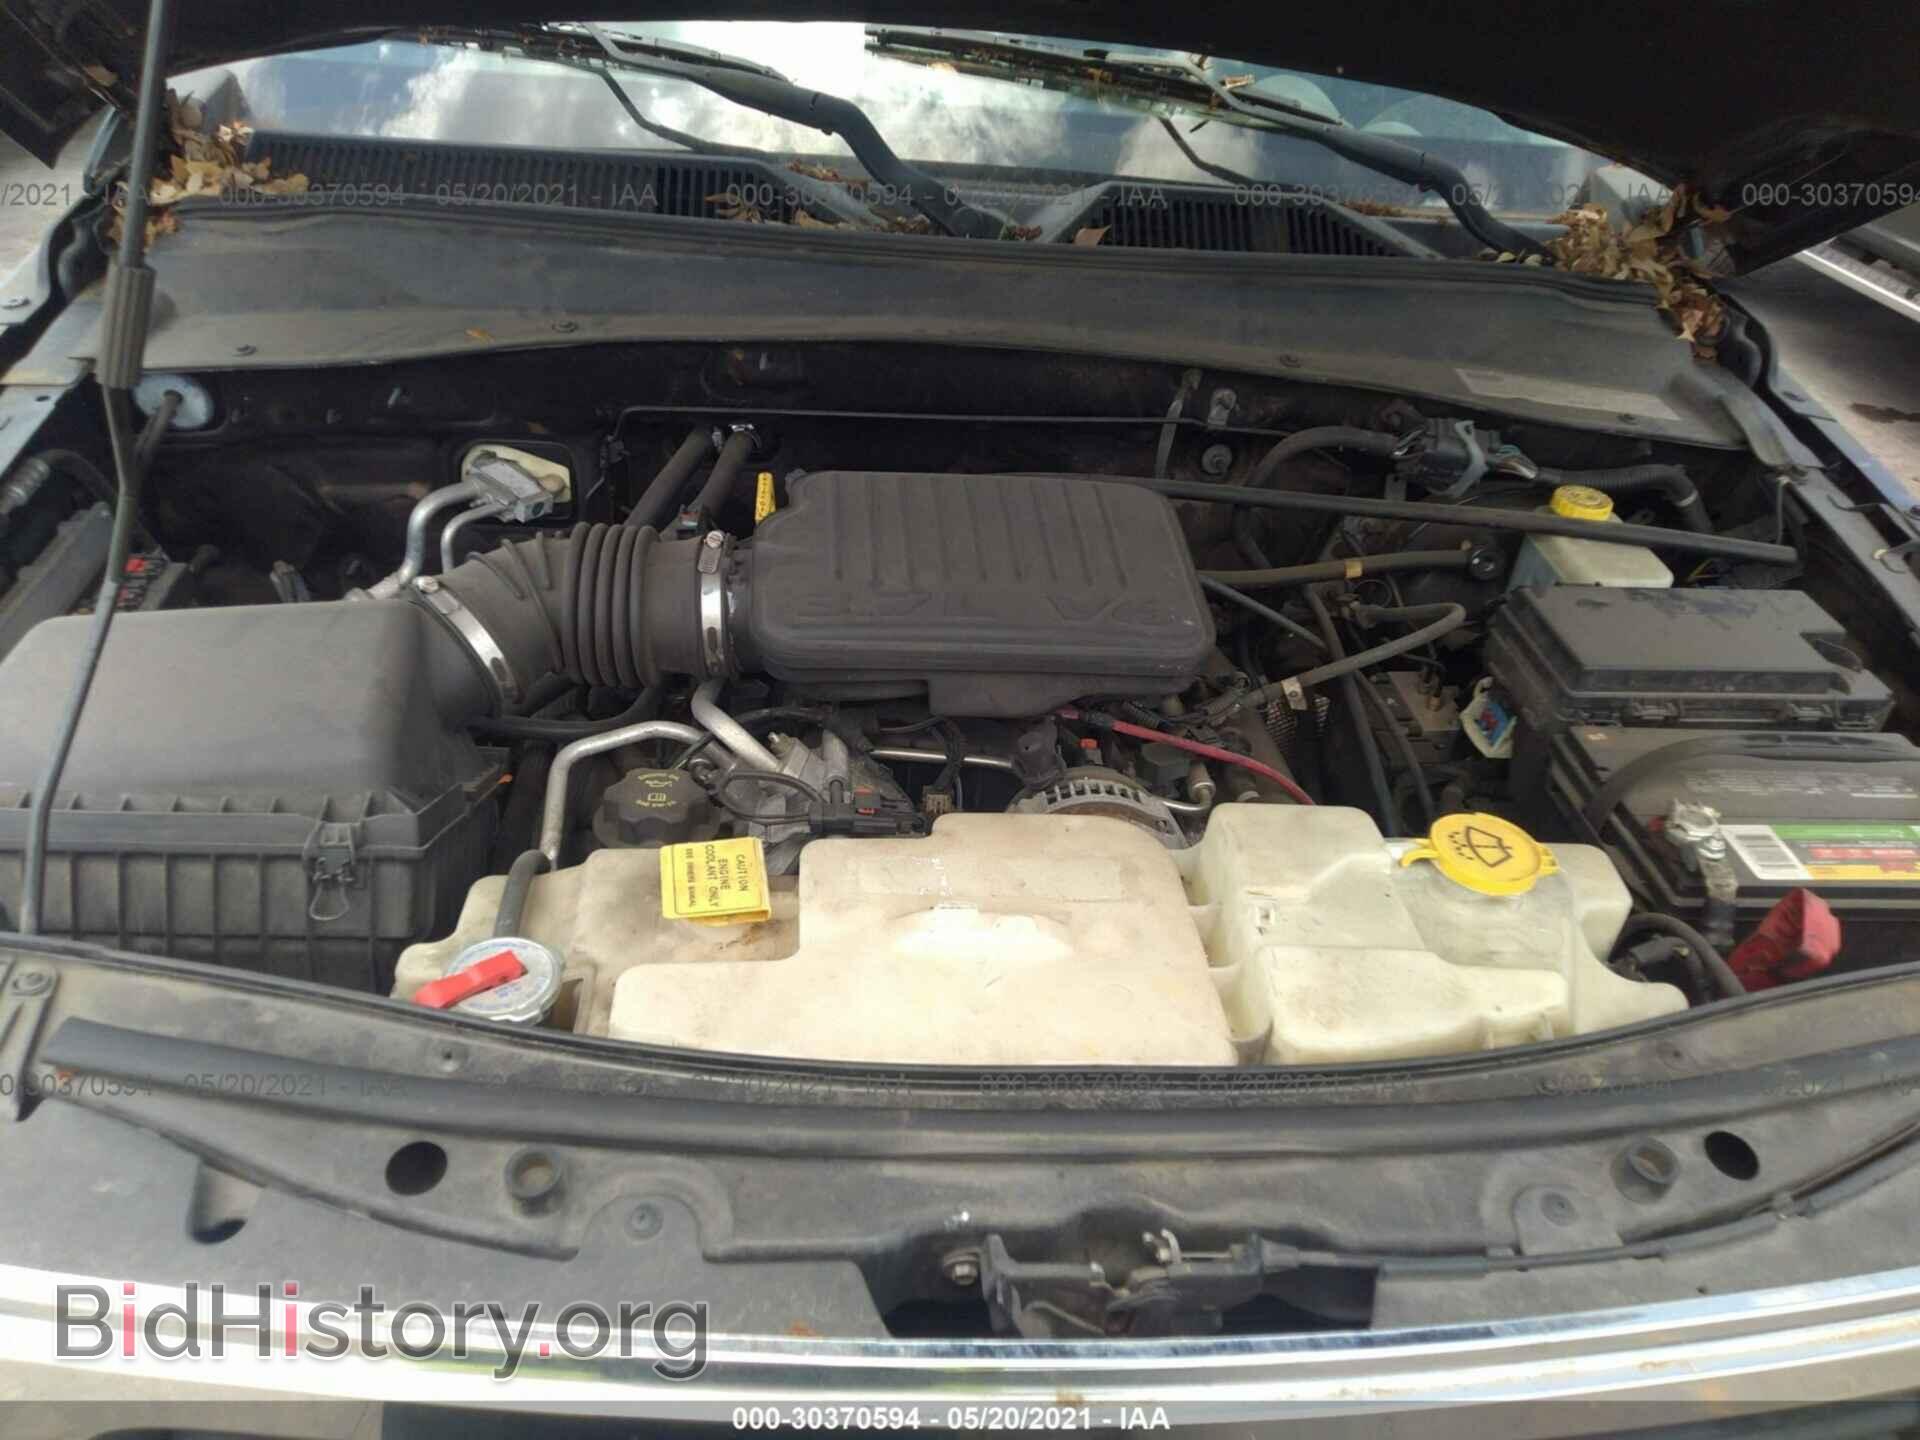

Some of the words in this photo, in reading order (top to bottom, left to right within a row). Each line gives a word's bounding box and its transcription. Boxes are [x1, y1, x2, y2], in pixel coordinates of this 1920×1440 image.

[705, 843, 718, 881] COOLANT
[718, 857, 731, 891] ENGINE
[735, 853, 749, 892] CAUTION
[708, 886, 720, 908] ONLY
